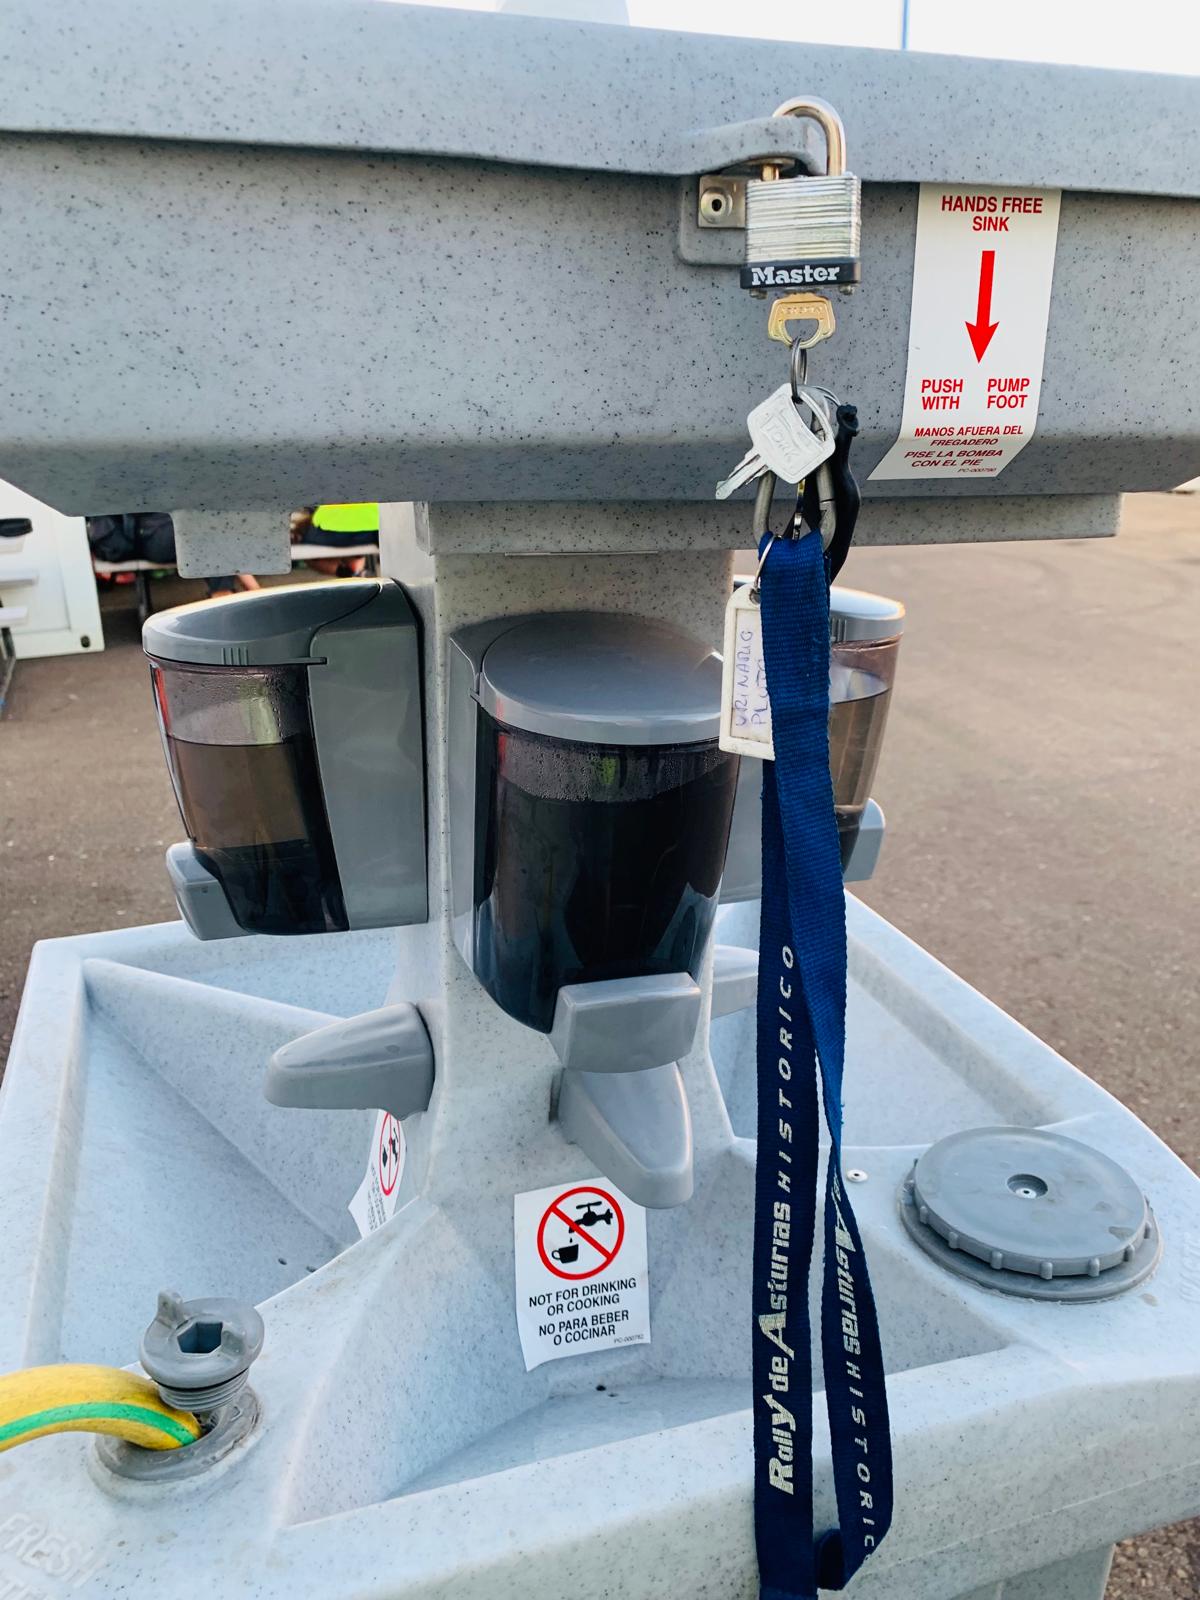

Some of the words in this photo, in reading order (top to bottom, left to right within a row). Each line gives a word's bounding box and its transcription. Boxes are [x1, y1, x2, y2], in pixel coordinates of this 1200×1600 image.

[941, 195, 998, 213] HANDS
[1002, 197, 1044, 214] FREE
[972, 216, 1010, 232] SINK
[751, 265, 840, 286] Master
[921, 379, 964, 394] PUSH
[987, 378, 1031, 393] PUMP
[921, 396, 961, 410] WITH
[987, 394, 1029, 409] FOOT
[914, 427, 955, 437] MANOS
[956, 426, 1000, 437] AFUERA
[1003, 425, 1024, 435] DEL
[930, 438, 999, 446] FREGADERO
[904, 450, 935, 459] PISE
[936, 450, 954, 458] LA
[956, 449, 1003, 457] BOMBA
[911, 460, 941, 468] CON
[942, 459, 957, 467] EL
[961, 458, 983, 466] PIE
[776, 945, 795, 1194] HISTORICO
[758, 1201, 795, 1361] Asturias
[528, 1293, 553, 1308] NOT
[555, 1287, 579, 1302] FOR
[582, 1277, 637, 1296] DRINKING
[547, 1302, 564, 1316] OR
[567, 1293, 620, 1313] COOKING
[539, 1322, 556, 1337] NO
[558, 1316, 588, 1333] PARA
[591, 1309, 630, 1326] BEBER
[553, 1334, 562, 1346] O
[565, 1325, 616, 1344] COCINAR
[768, 1356, 790, 1392] de
[763, 1394, 797, 1497] Rally
